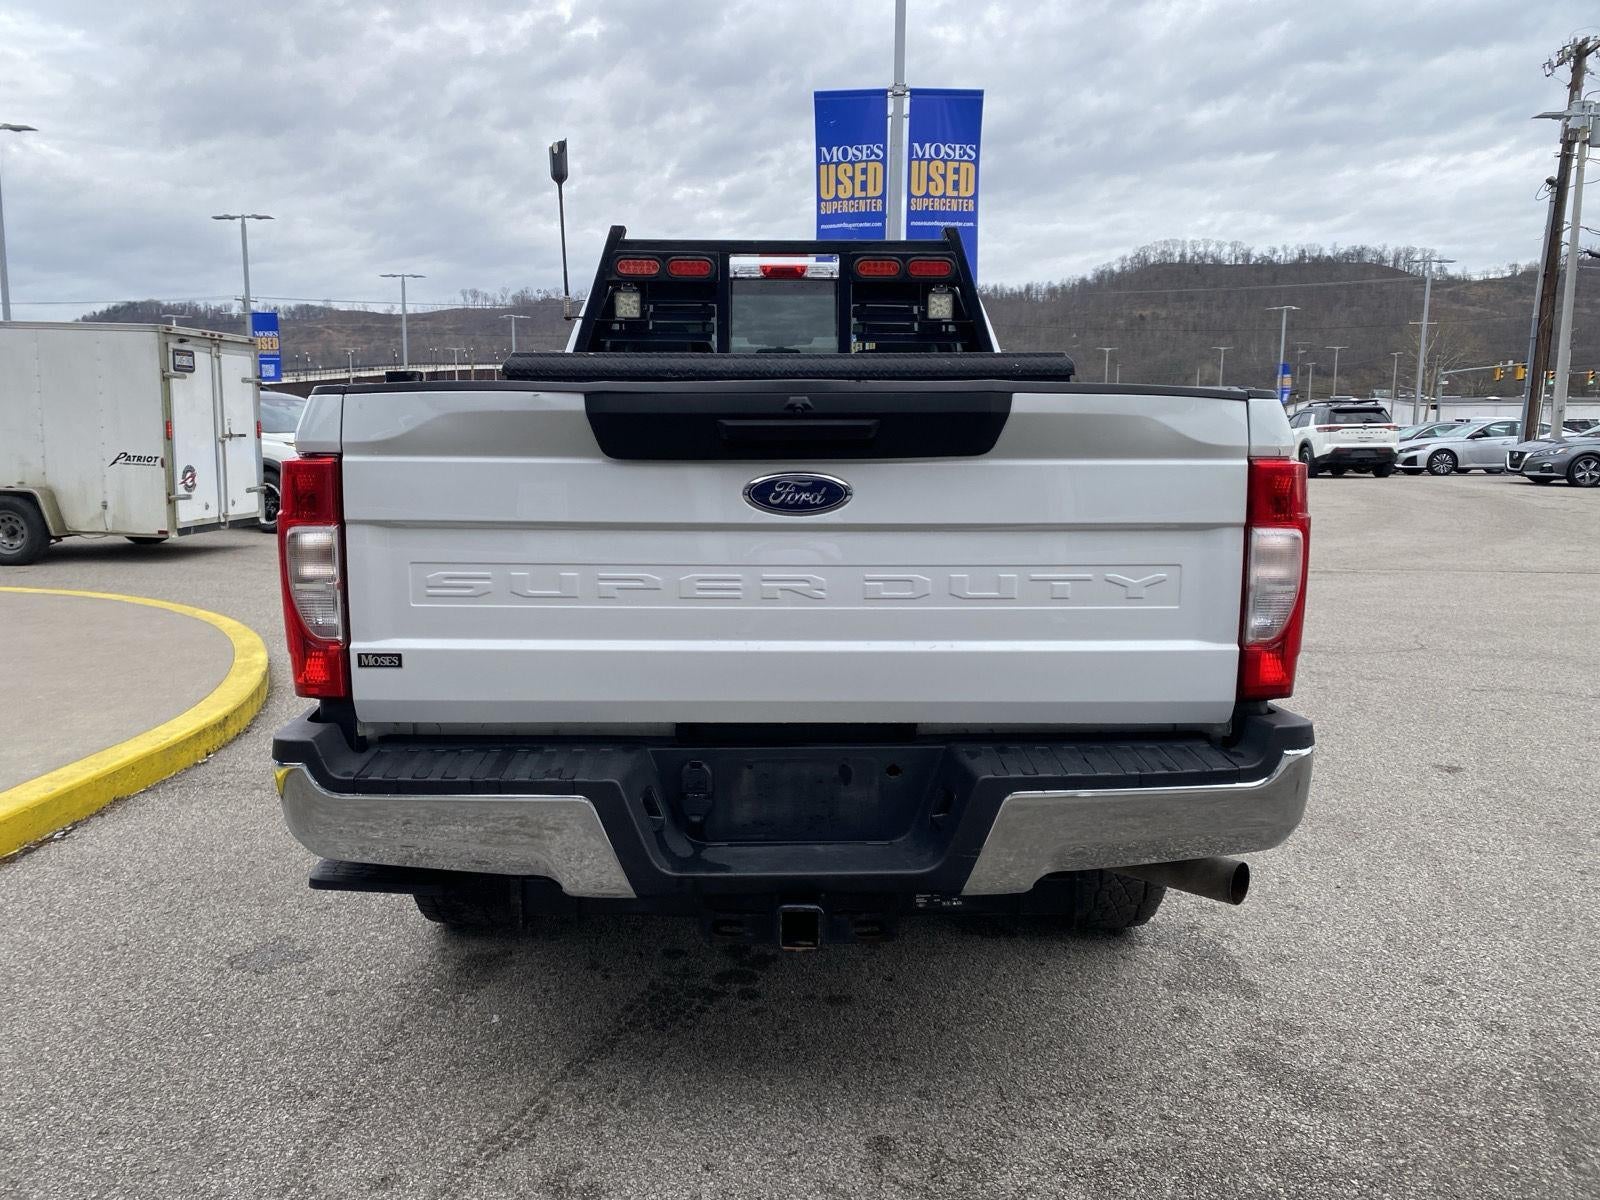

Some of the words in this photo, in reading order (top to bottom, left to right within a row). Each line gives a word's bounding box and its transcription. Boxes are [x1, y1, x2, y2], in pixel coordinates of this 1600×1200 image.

[820, 144, 884, 162] MOSES
[912, 143, 976, 161] MOSES
[820, 162, 884, 200] USED
[911, 161, 976, 197] USED
[820, 199, 883, 214] SUPERCENTER
[910, 199, 975, 211] SUPERCENTER
[108, 452, 160, 467] PATRIOT
[769, 481, 827, 504] Ford
[426, 571, 826, 600] SUPER
[864, 573, 1167, 600] DUTY
[360, 654, 399, 666] MOSES
